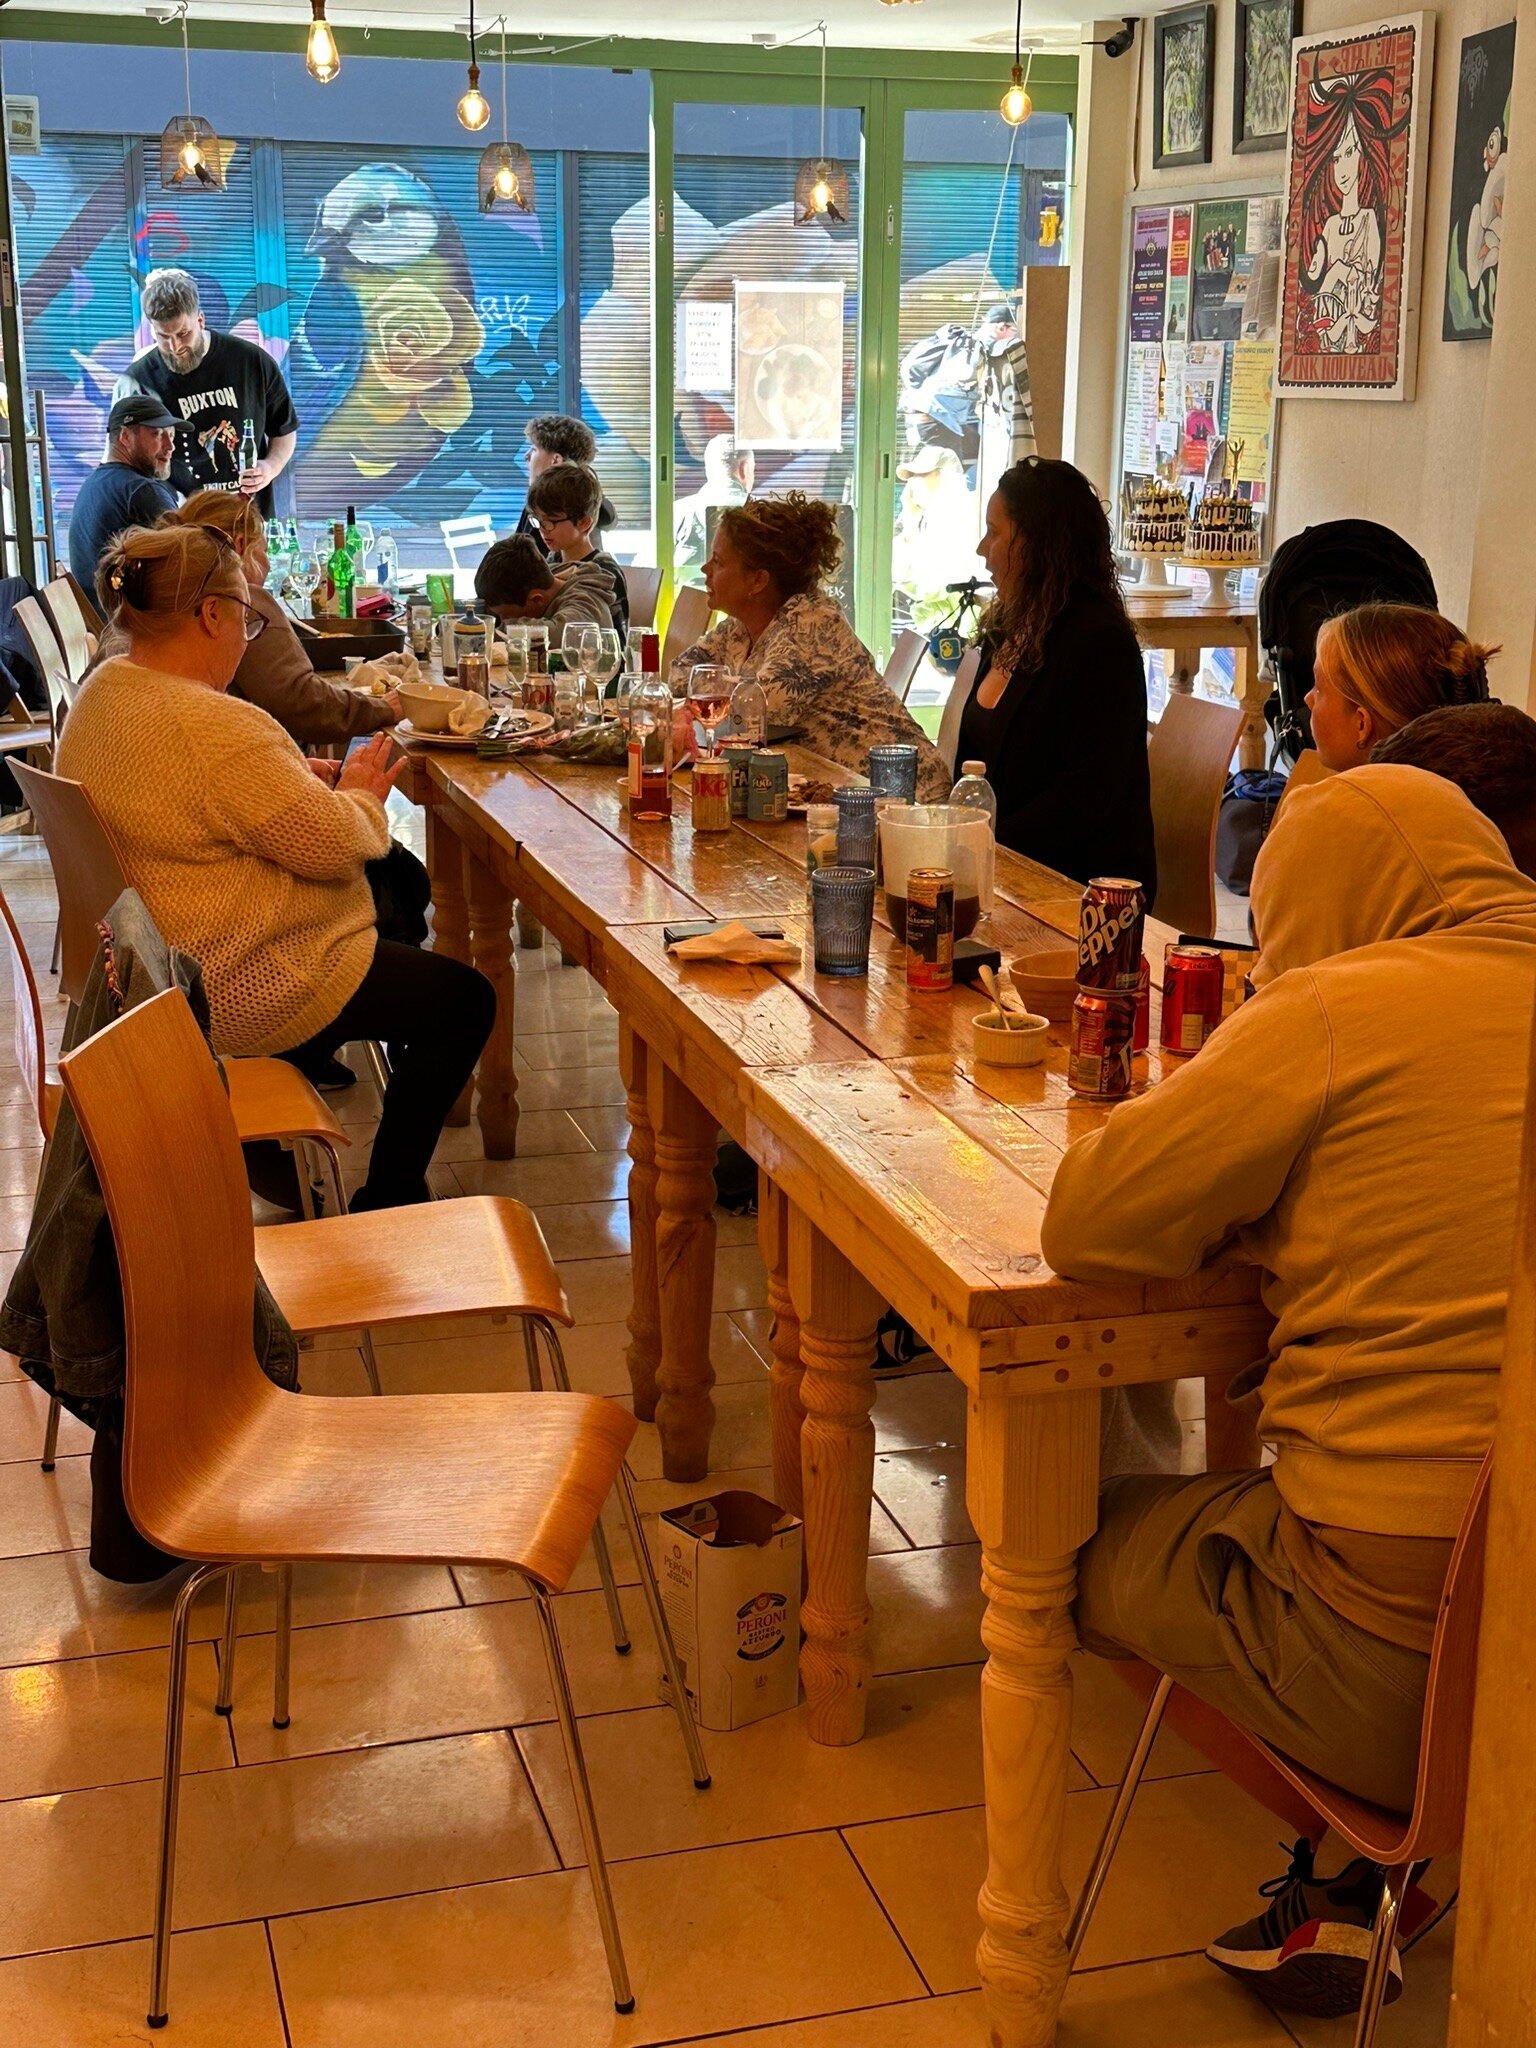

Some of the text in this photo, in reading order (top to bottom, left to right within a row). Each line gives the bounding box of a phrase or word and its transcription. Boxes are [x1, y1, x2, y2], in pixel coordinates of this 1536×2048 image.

[1294, 355, 1387, 381] INK NOUVEAU
[178, 387, 239, 420] BUXTON
[1079, 894, 1139, 966] epper
[1082, 903, 1107, 939] Dr
[737, 1609, 787, 1635] PERONI
